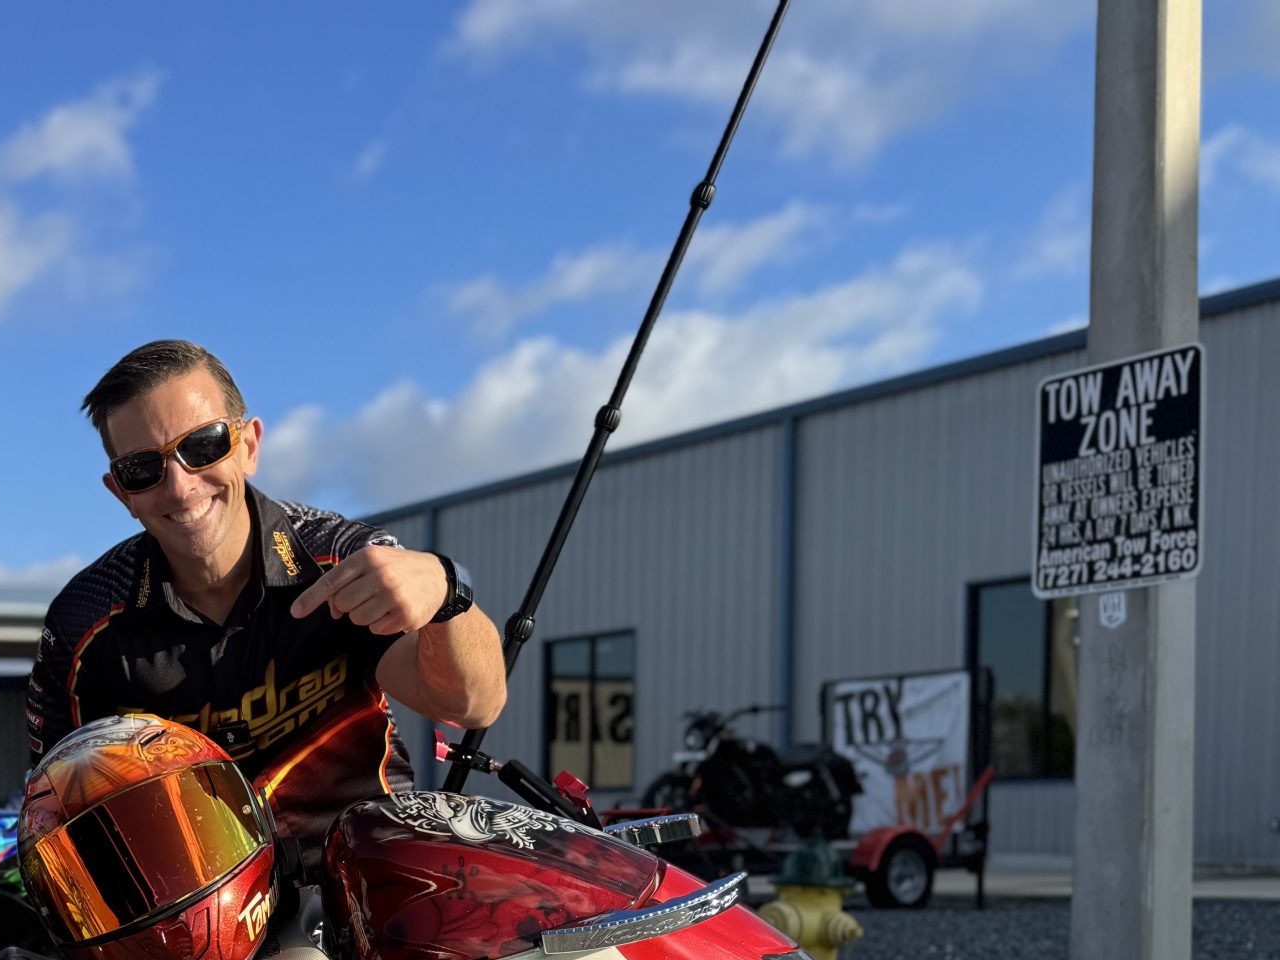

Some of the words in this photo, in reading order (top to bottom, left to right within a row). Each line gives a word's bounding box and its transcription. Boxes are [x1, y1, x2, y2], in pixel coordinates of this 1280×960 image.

[1045, 372, 1103, 424] TOW
[1115, 350, 1195, 409] AWAY
[1078, 402, 1156, 457] ZONE
[1042, 449, 1131, 486] UNAUTHORIZED
[1135, 436, 1195, 468] VEHICLES
[1061, 475, 1106, 503] VESSELS
[1109, 470, 1133, 495] WILL
[1137, 467, 1153, 490] BE
[1157, 459, 1195, 485] TOWED
[1091, 491, 1138, 519] OWNERS
[1142, 481, 1194, 511] EXPENSE
[1130, 508, 1158, 534] DAYS
[1039, 542, 1111, 568] American
[1114, 535, 1147, 557] Tow
[1151, 529, 1196, 550] Force
[1039, 562, 1089, 589] (727)
[1093, 548, 1196, 582] 244-2160
[834, 677, 903, 746] TRY
